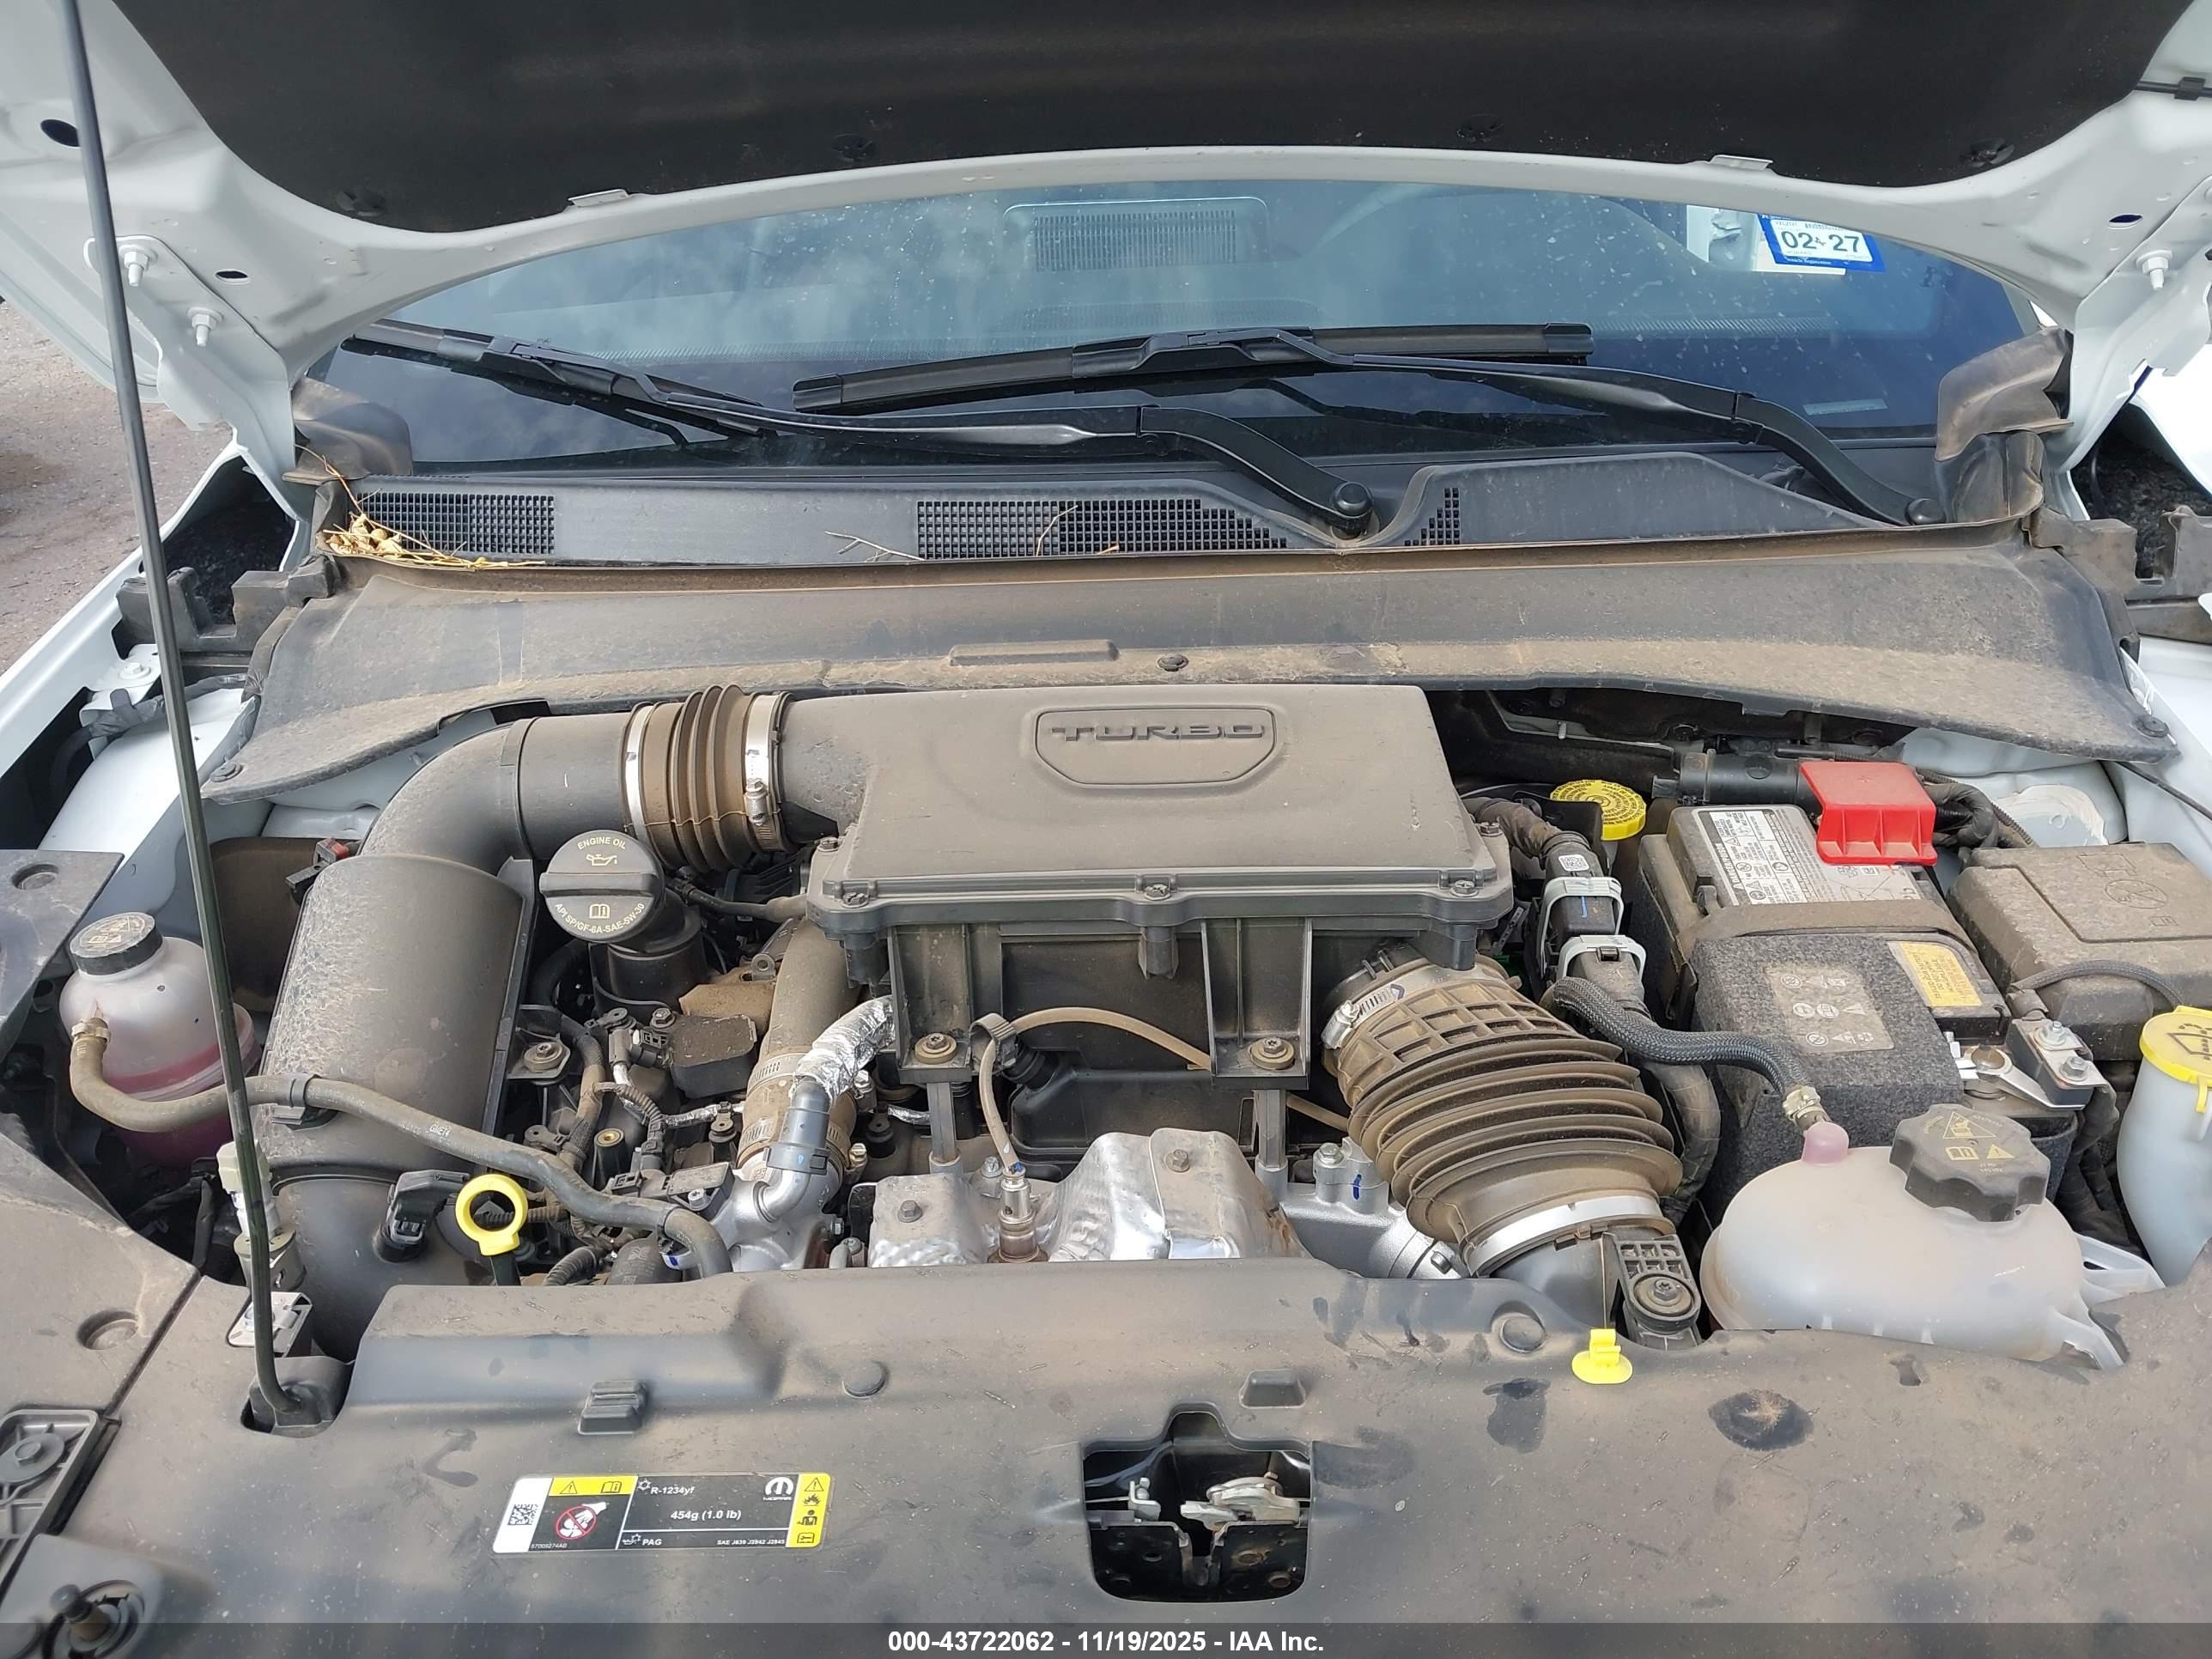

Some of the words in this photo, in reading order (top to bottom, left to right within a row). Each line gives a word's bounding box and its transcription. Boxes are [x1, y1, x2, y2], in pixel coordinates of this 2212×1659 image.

[1781, 230, 1817, 250] 02
[1828, 234, 1860, 252] 27
[1050, 723, 1265, 742] TURBO
[577, 836, 612, 850] ENGINE
[613, 838, 627, 850] OIL
[555, 903, 568, 919] API
[650, 1485, 695, 1495] R-1234yf
[670, 1510, 699, 1522] 454g
[702, 1510, 723, 1522] (1.0
[726, 1510, 742, 1521] lb)
[642, 1538, 662, 1547] PAG
